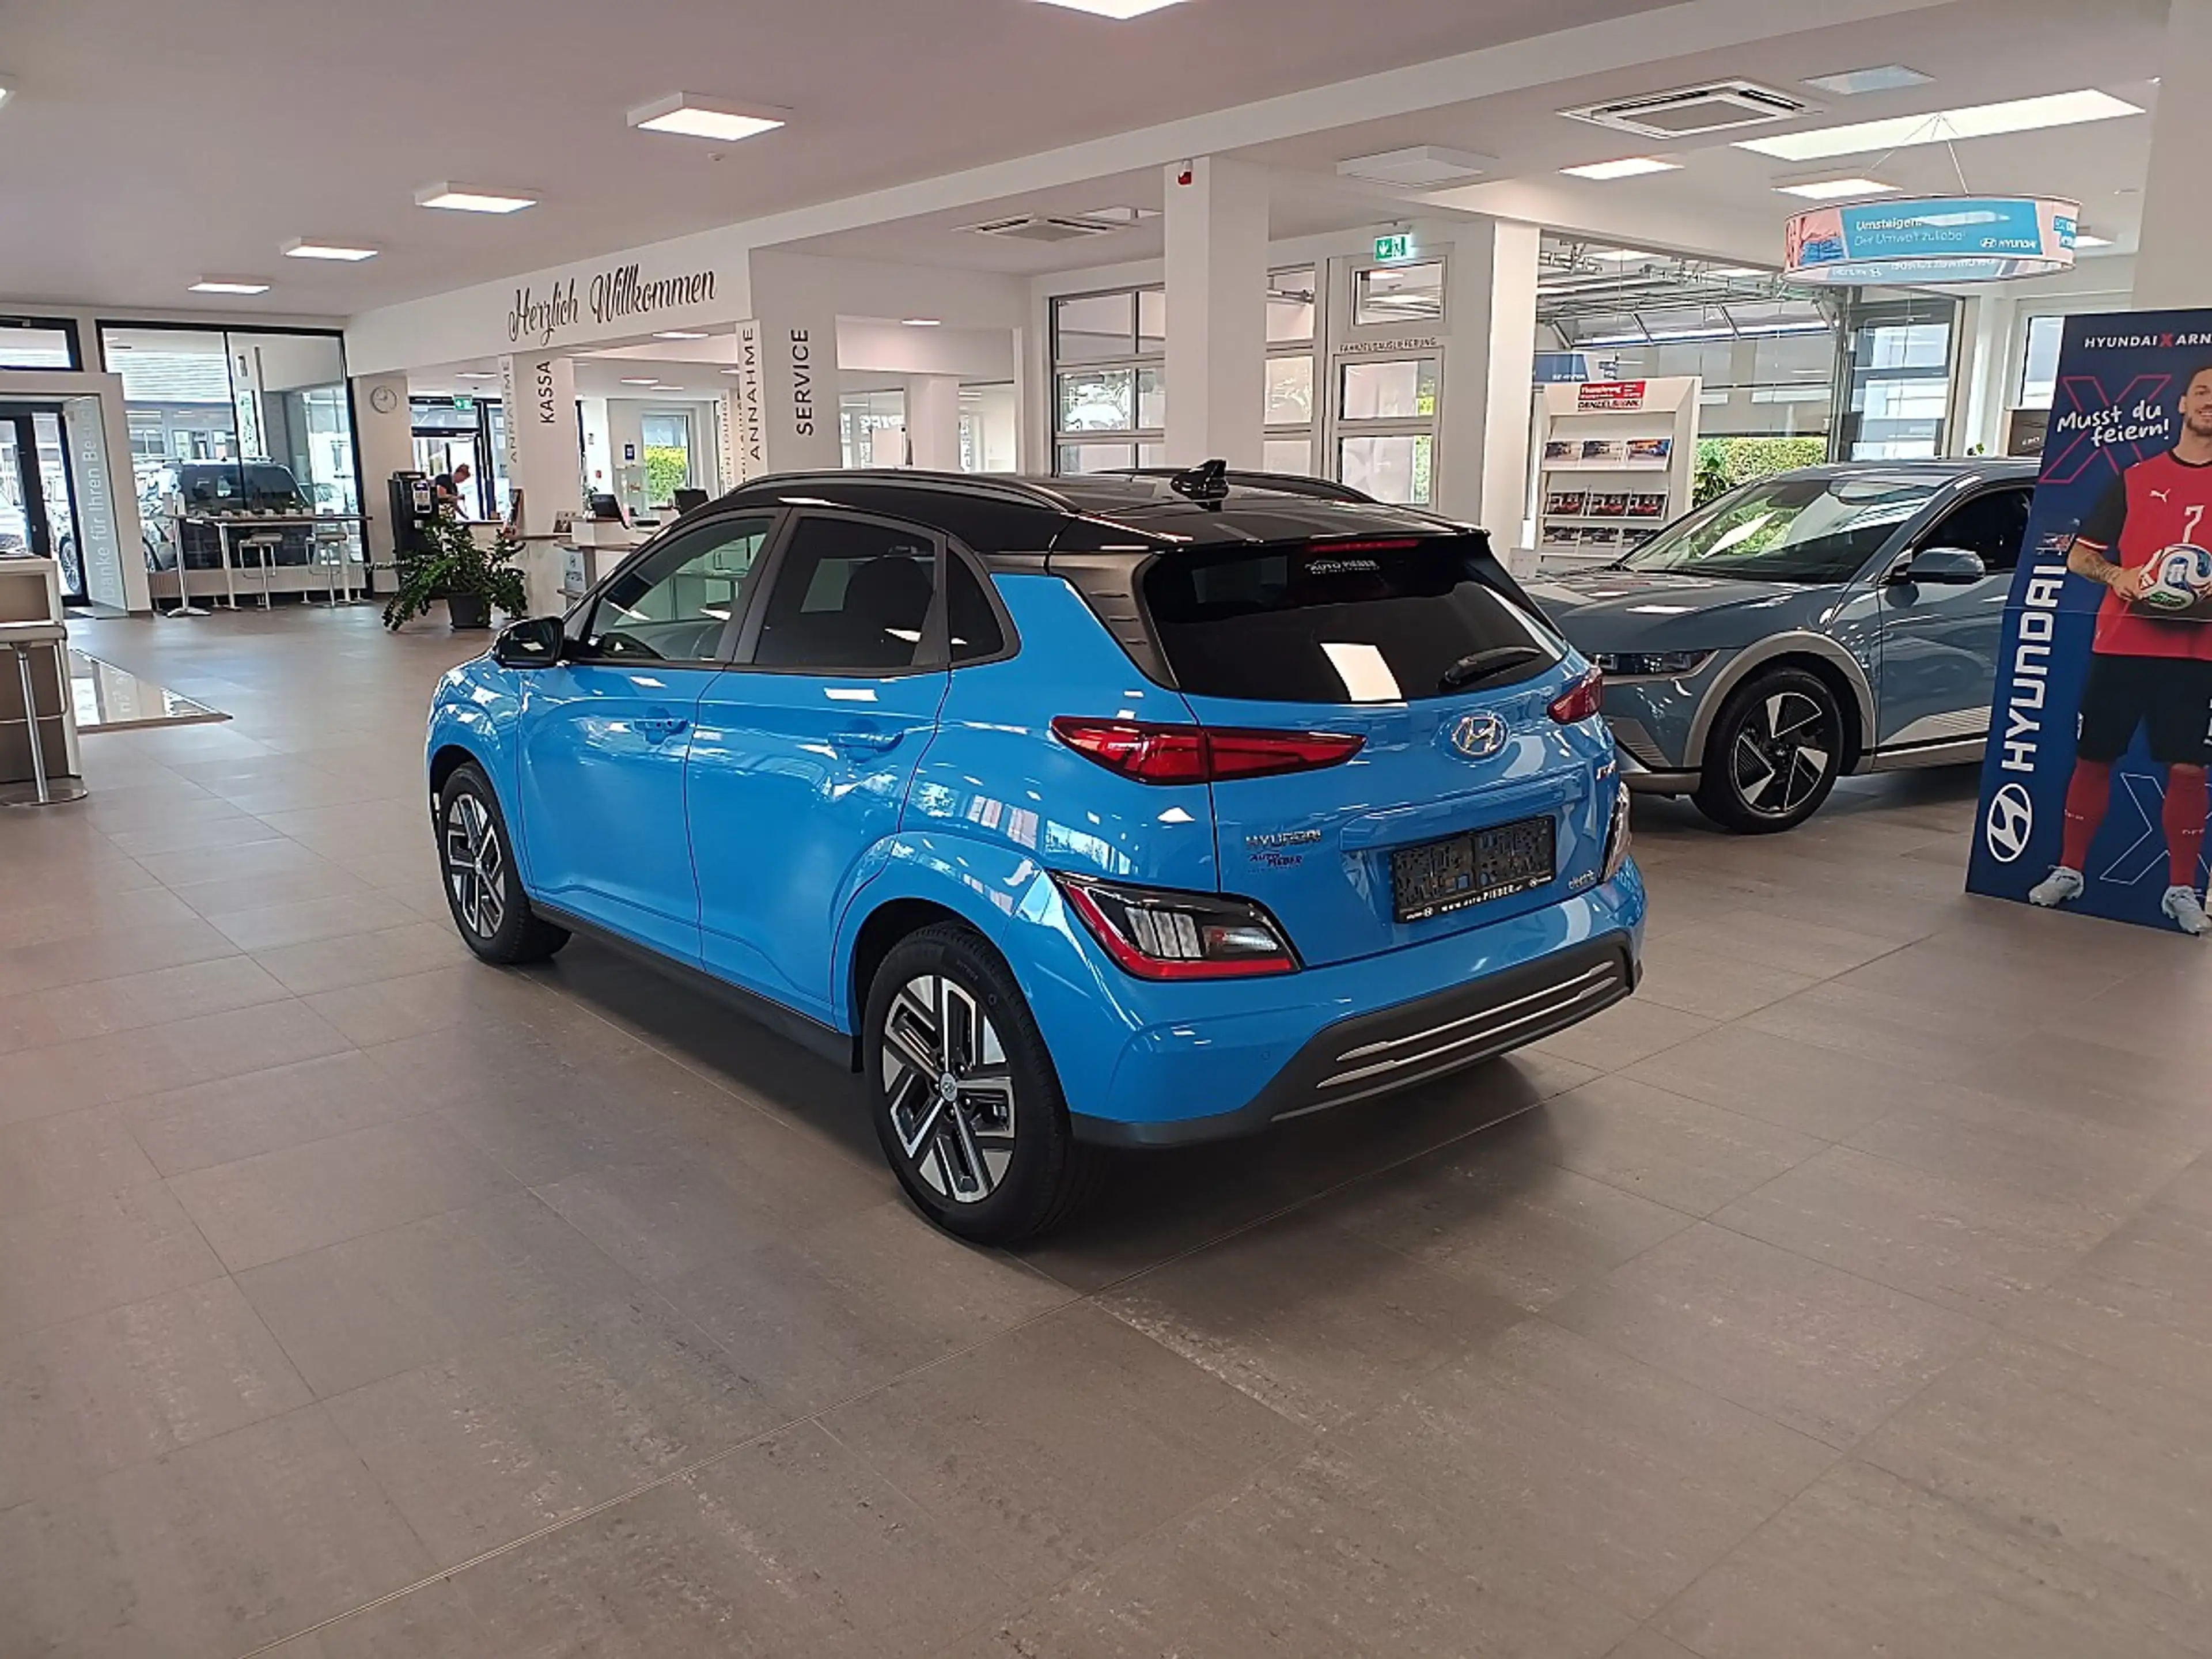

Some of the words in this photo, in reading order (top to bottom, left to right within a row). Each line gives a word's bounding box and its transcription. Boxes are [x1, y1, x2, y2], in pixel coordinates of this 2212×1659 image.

[1876, 231, 1918, 244] Umwelt
[1998, 239, 2036, 248] HYUNDAI
[509, 278, 578, 346] Herzlich
[589, 263, 715, 324] Willkommen
[2084, 335, 2158, 349] HYUNDAI
[2175, 333, 2212, 346] ARN
[536, 361, 555, 423] KASSA
[743, 328, 761, 461] ANNAHME
[790, 329, 814, 436] SERVICE
[2057, 405, 2123, 433] Musst
[2133, 400, 2161, 422] du
[2090, 418, 2169, 448] feiern!
[88, 467, 104, 511] Ihren
[92, 518, 108, 541] für
[2184, 505, 2206, 543] 7
[94, 547, 115, 599] Danke
[2001, 565, 2067, 772] HYUNDAI
